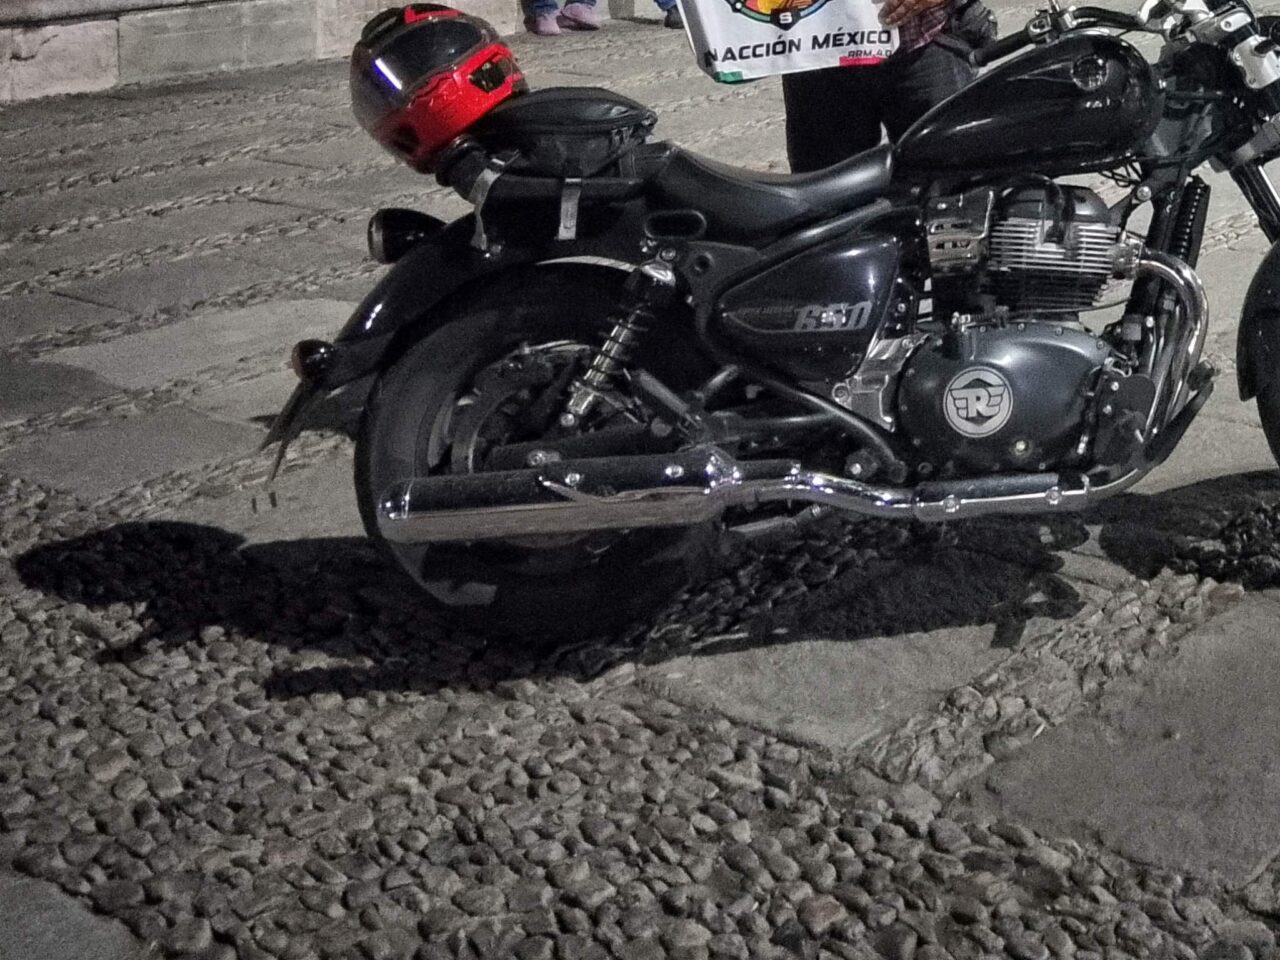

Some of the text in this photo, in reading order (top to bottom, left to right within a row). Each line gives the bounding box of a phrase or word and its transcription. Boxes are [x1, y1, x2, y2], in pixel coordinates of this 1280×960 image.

[779, 12, 793, 24] S
[721, 35, 802, 62] ACCIÓN
[811, 27, 892, 50] MÉXICO
